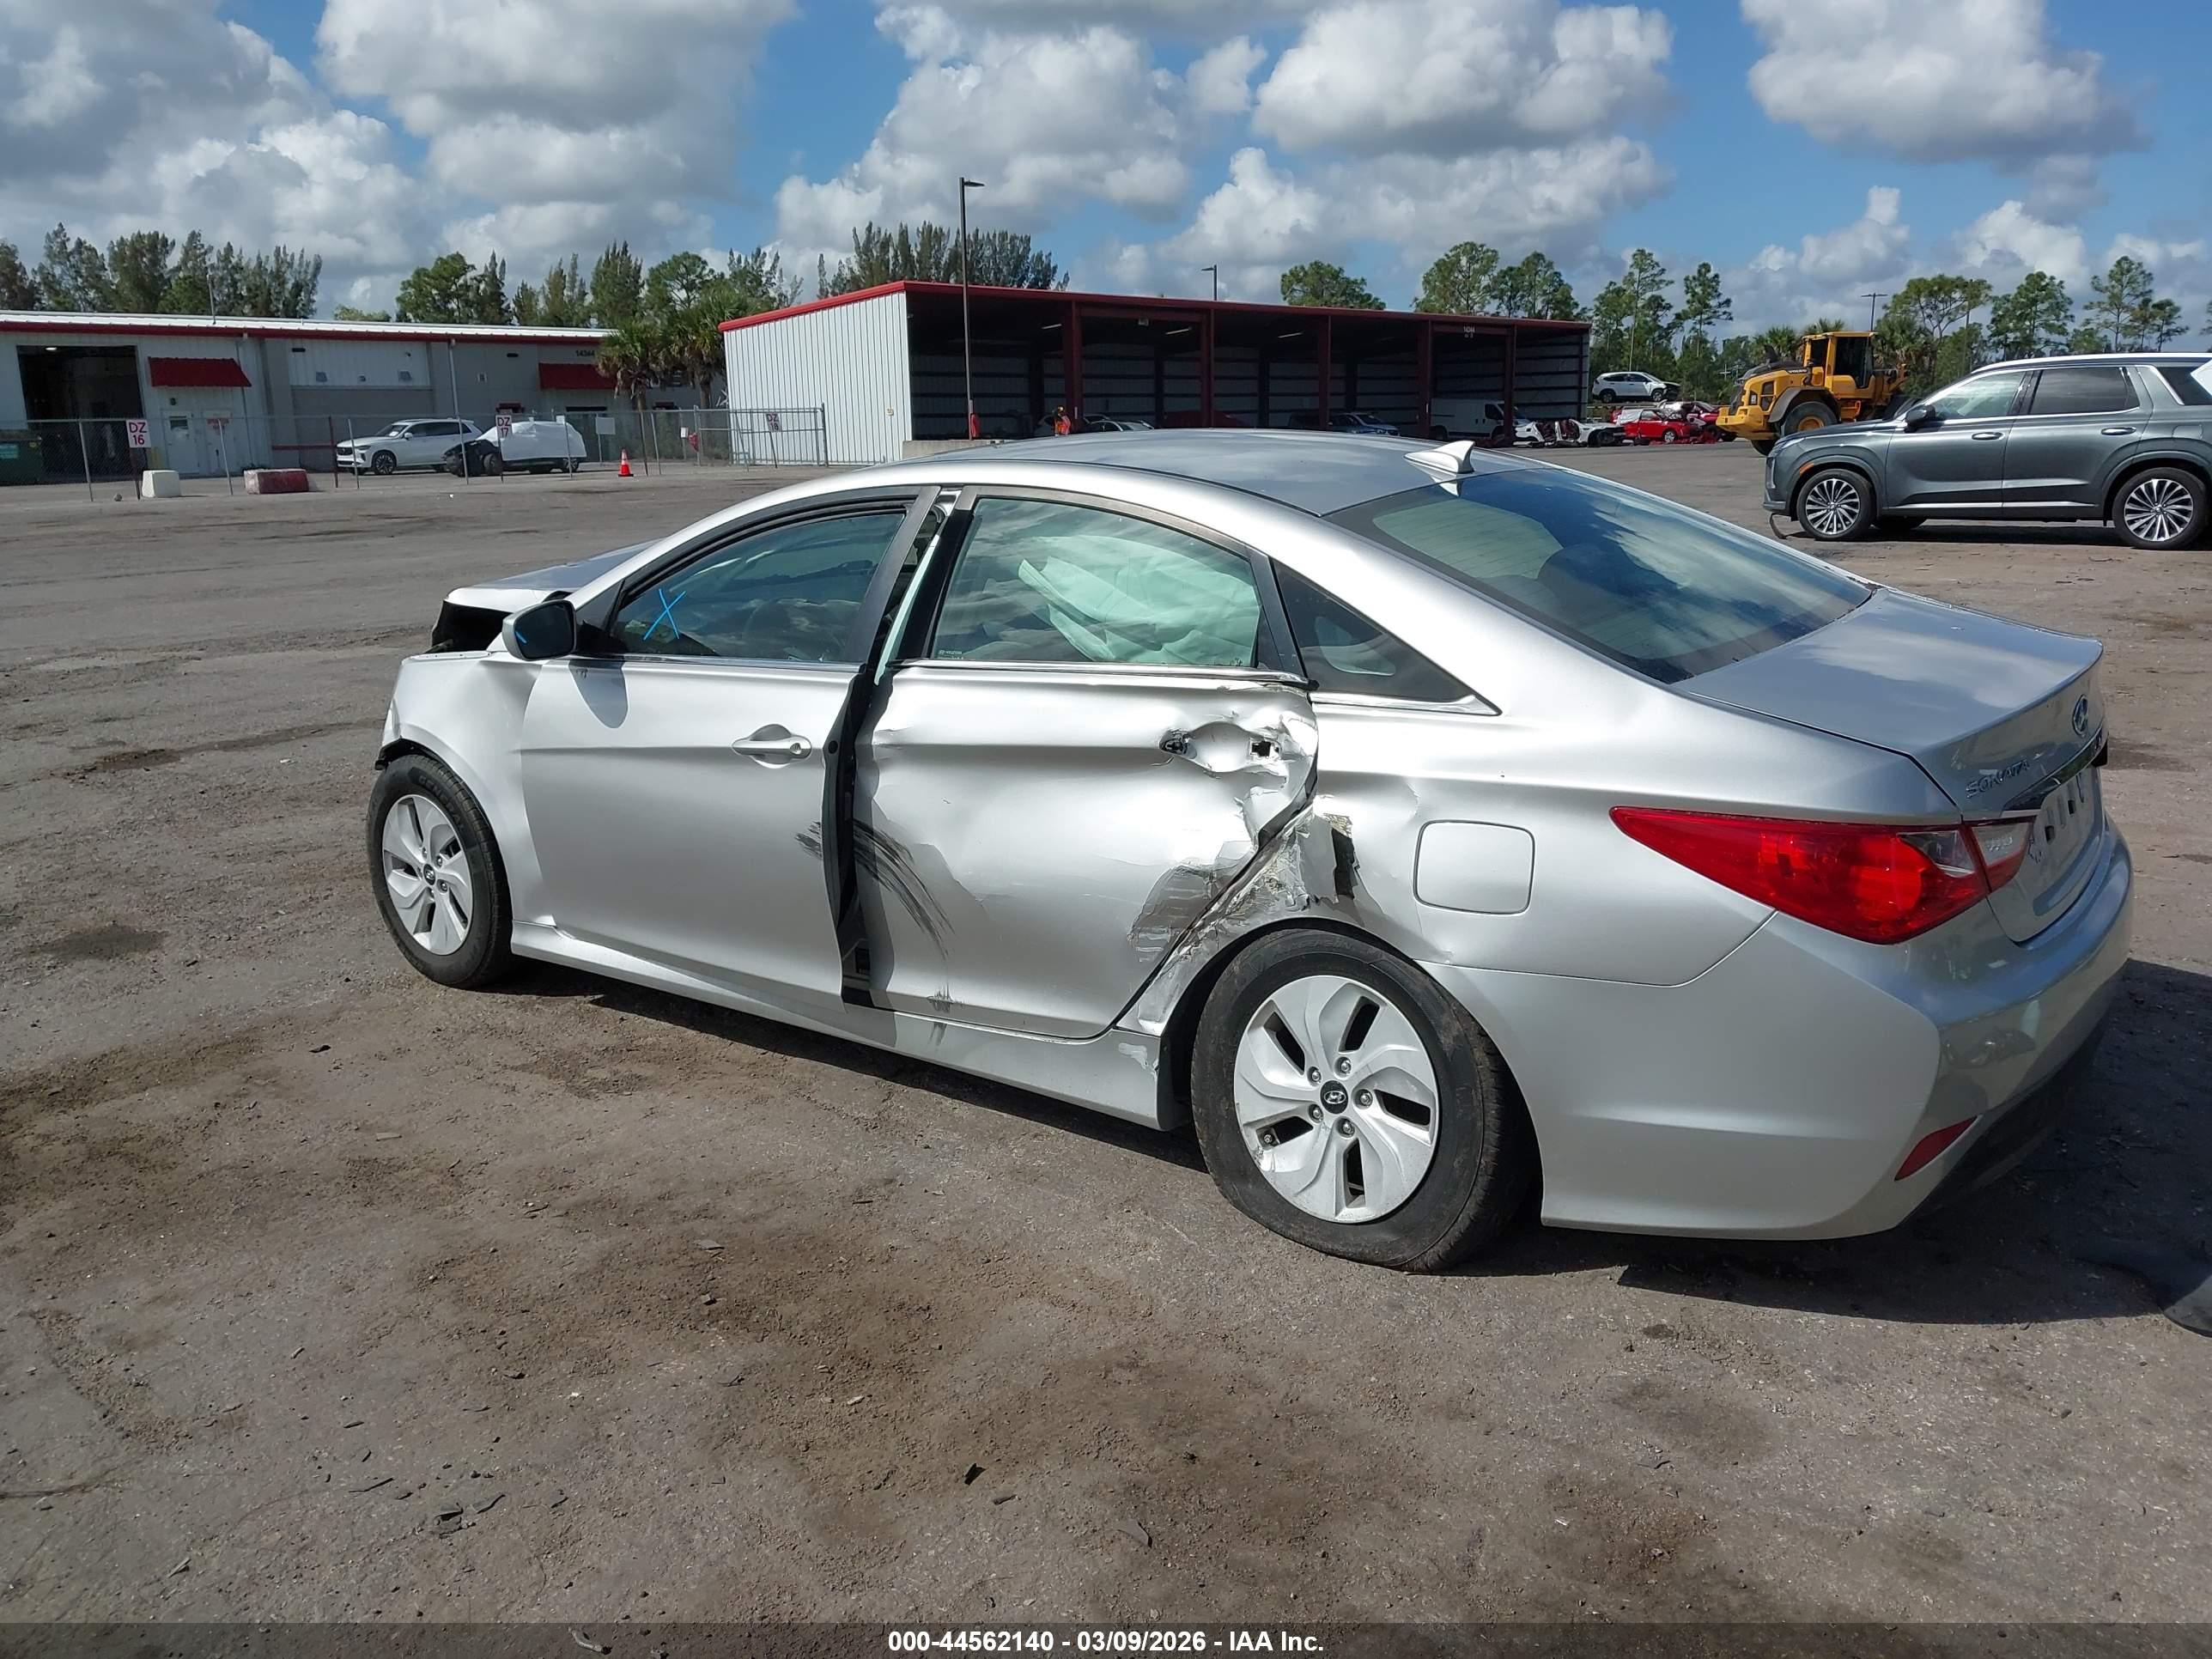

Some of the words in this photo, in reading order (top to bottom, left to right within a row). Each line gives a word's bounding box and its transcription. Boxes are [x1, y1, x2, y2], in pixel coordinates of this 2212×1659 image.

[497, 416, 511, 427] DZ
[766, 413, 779, 422] DZ
[129, 422, 147, 434] DZ
[770, 422, 779, 431] 18
[501, 428, 509, 438] 17
[133, 434, 145, 445] 16
[1966, 758, 2030, 799] SONATA
